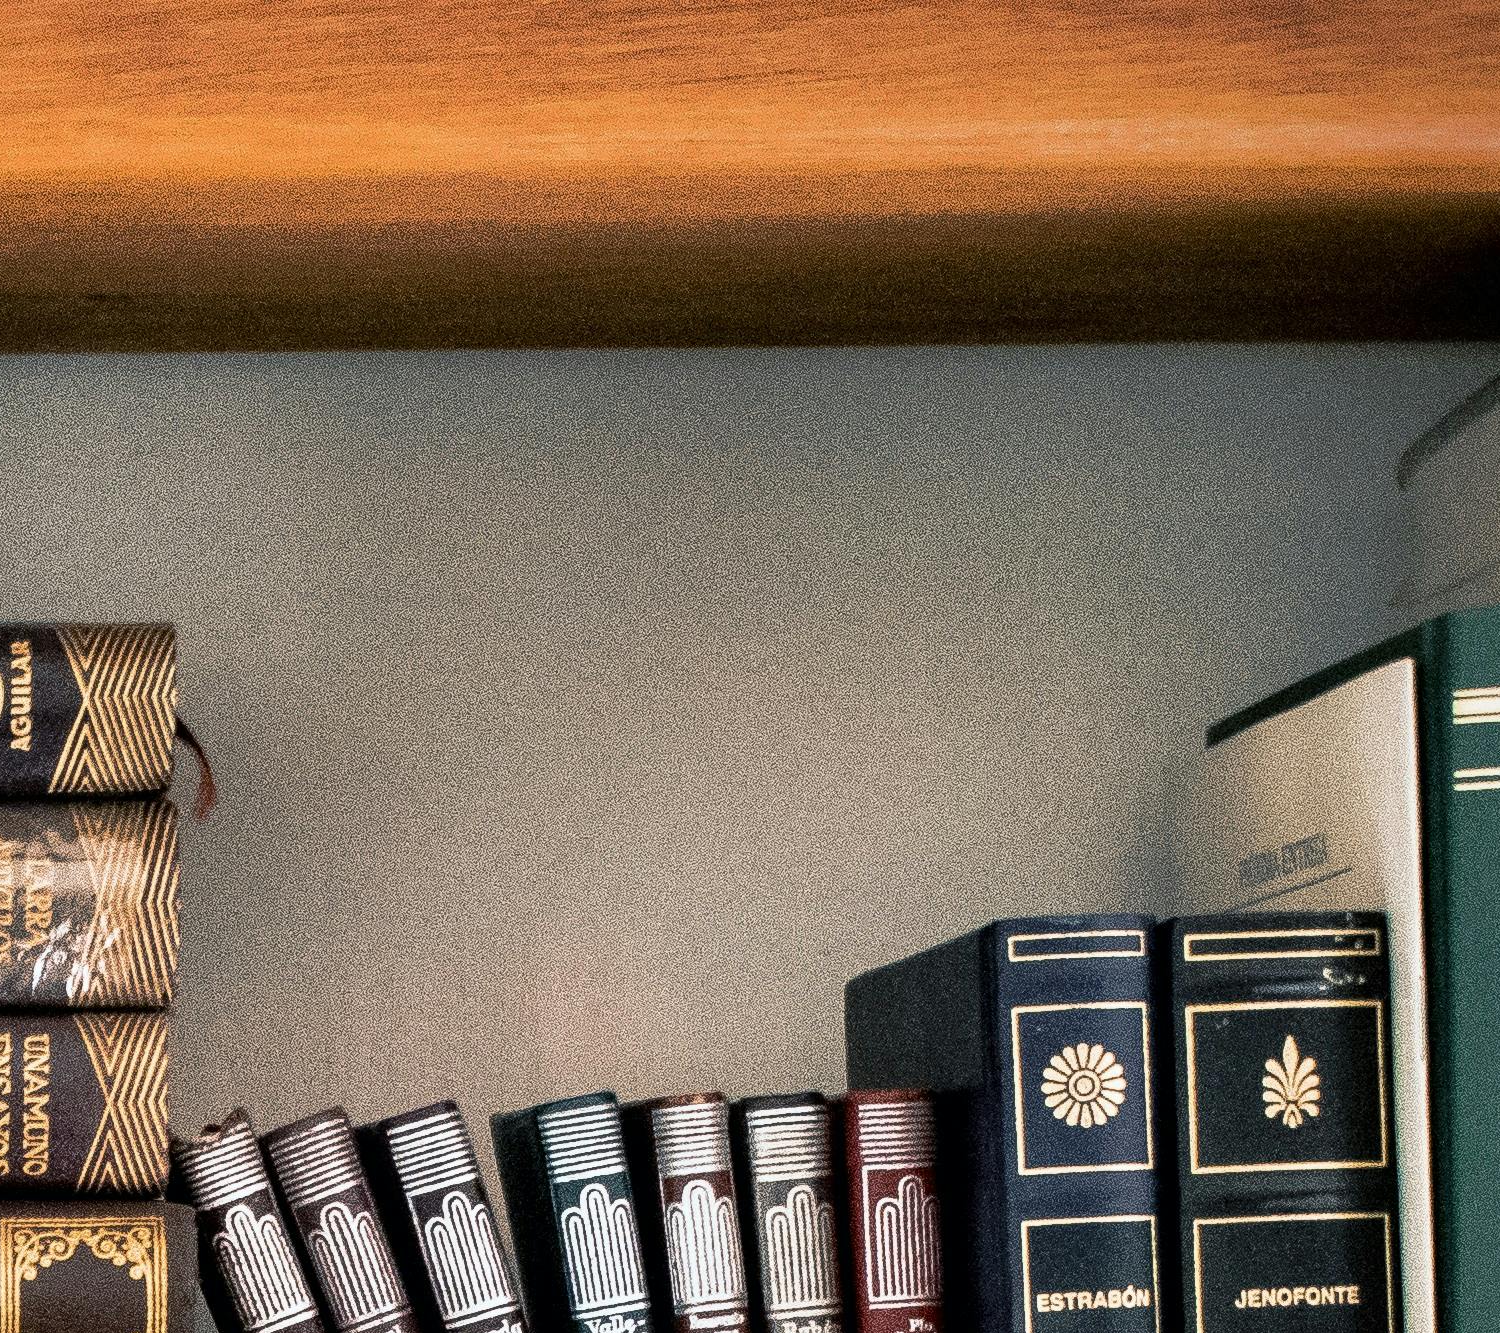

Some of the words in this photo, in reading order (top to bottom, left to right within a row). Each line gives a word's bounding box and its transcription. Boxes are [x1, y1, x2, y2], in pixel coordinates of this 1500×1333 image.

[10, 642, 32, 751] AGUILAR
[22, 1033, 51, 1175] UNAMUNO
[1036, 1285, 1150, 1313] ESTRABÓN
[1234, 1285, 1359, 1309] JENOFONTE
